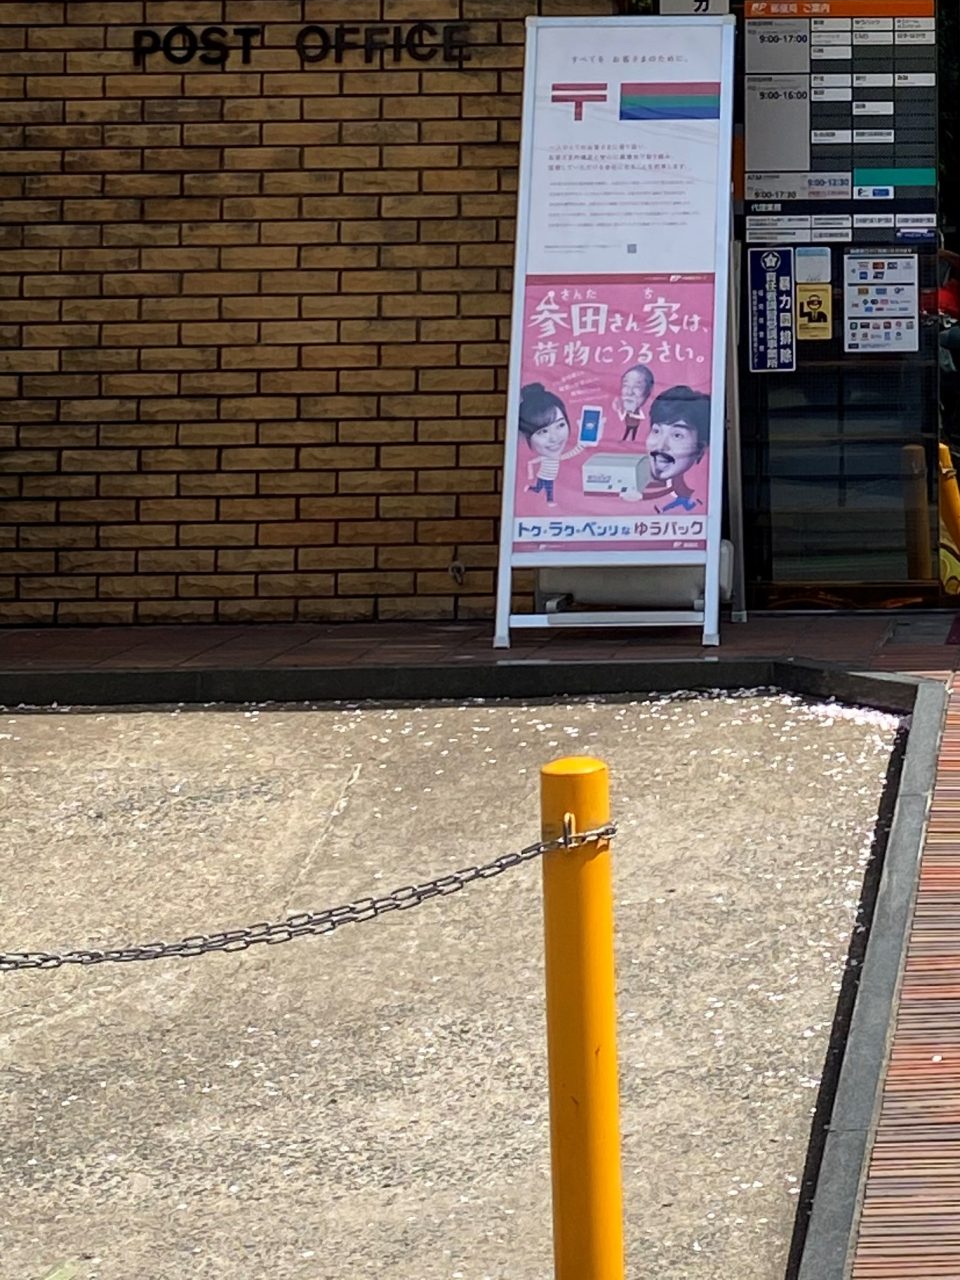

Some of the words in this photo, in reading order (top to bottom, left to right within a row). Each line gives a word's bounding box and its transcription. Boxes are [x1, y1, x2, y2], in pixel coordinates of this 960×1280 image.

[132, 25, 263, 67] POST
[295, 23, 473, 64] OFFICE
[759, 34, 808, 44] 9:00-17:00
[759, 91, 808, 100] 9:00-16:00
[532, 340, 705, 367] 荷物にうるさい。
